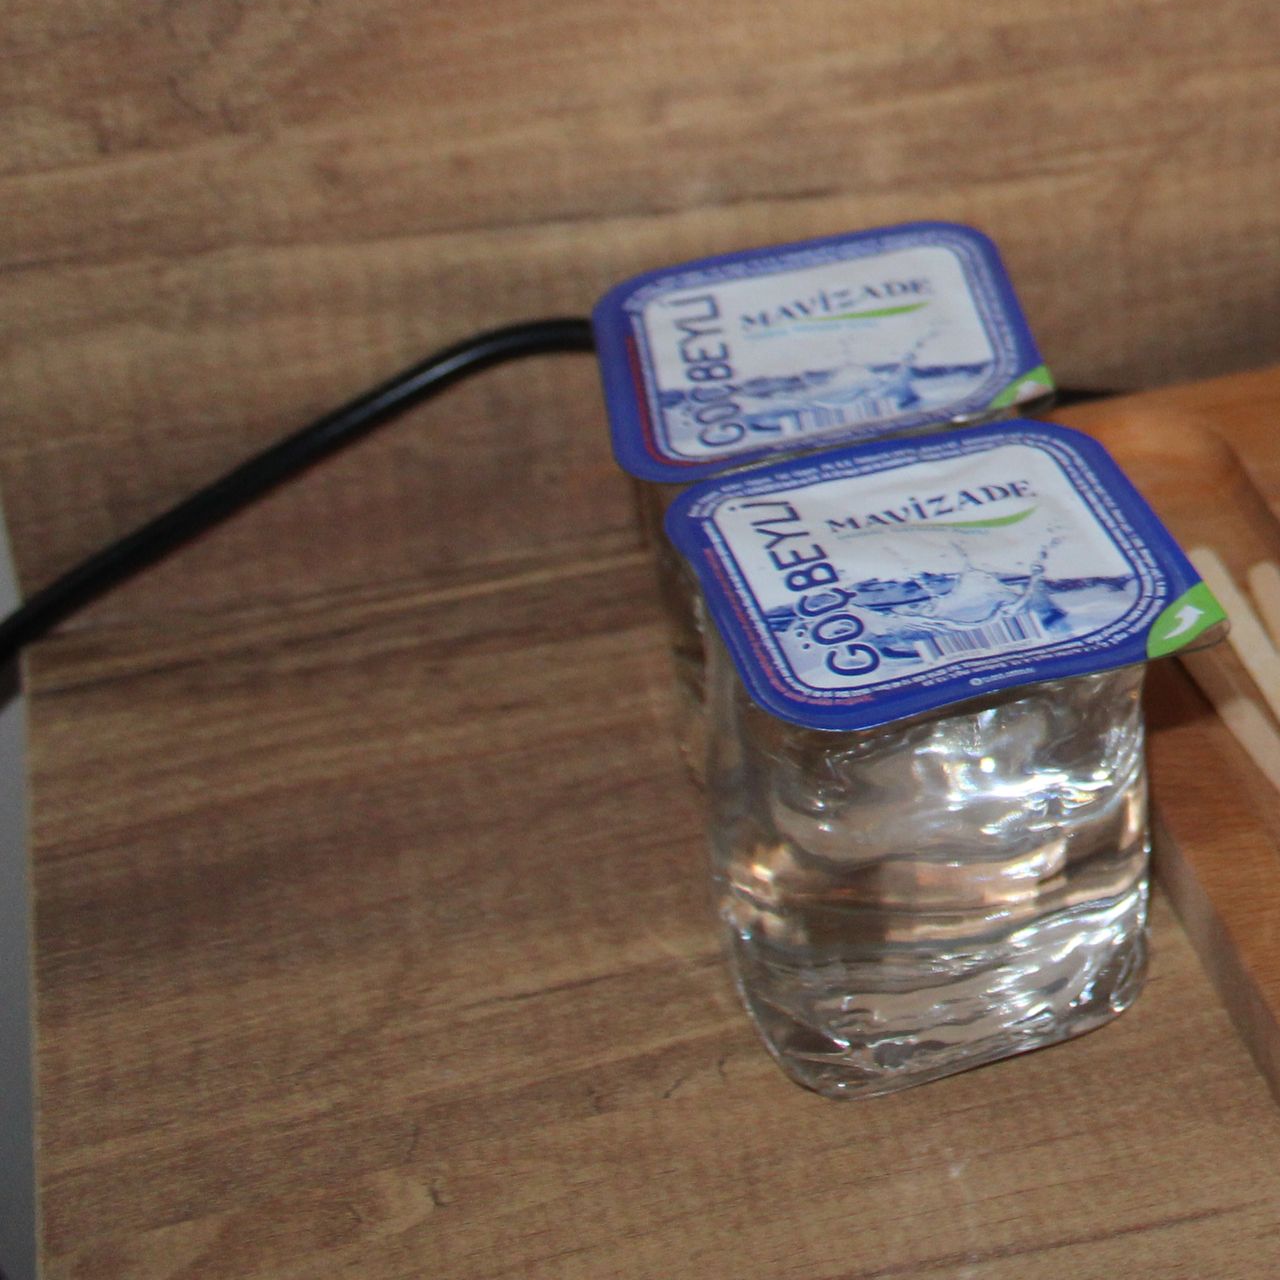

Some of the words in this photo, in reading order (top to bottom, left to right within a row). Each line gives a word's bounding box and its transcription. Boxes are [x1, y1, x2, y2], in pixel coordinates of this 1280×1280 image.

[740, 277, 934, 328] MAVİZADE
[824, 480, 1036, 533] MAVİZADE
[728, 500, 880, 677] GÖÇBEYLİ
